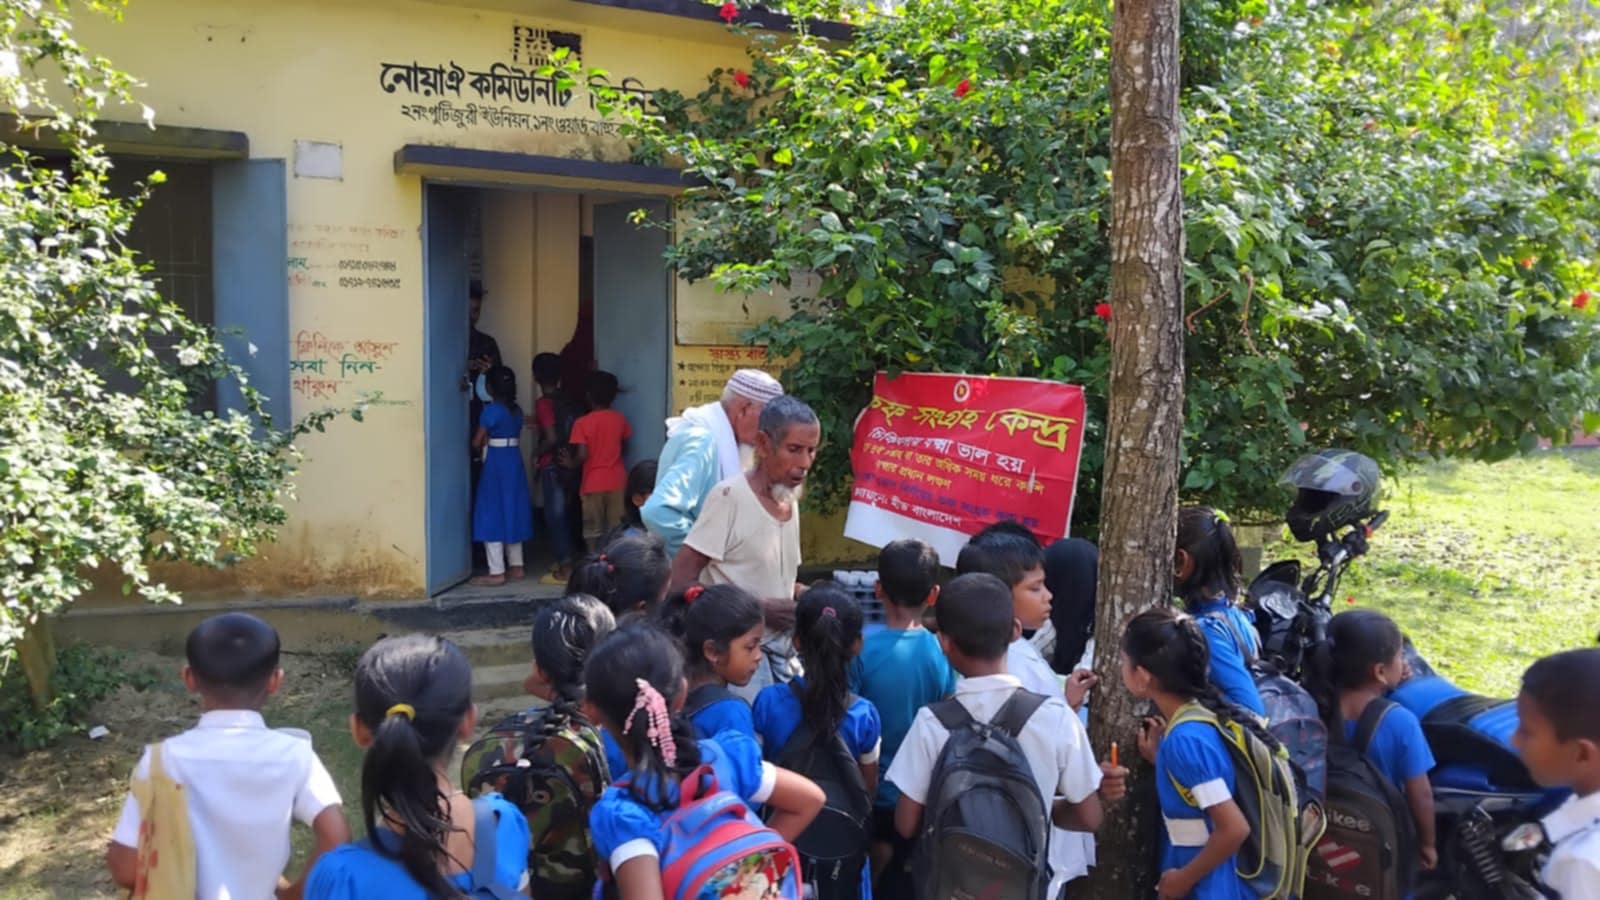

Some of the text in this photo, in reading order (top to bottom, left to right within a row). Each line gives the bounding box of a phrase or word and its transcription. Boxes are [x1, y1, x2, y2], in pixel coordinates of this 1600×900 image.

[469, 63, 574, 107] কমিউনিটি
[912, 405, 986, 429] সংগ্রহ
[985, 408, 1077, 452] কেন্দ্র
[957, 442, 992, 466] ভাল
[994, 452, 1026, 474] হয়
[911, 504, 962, 527] বাংলাদেশ
